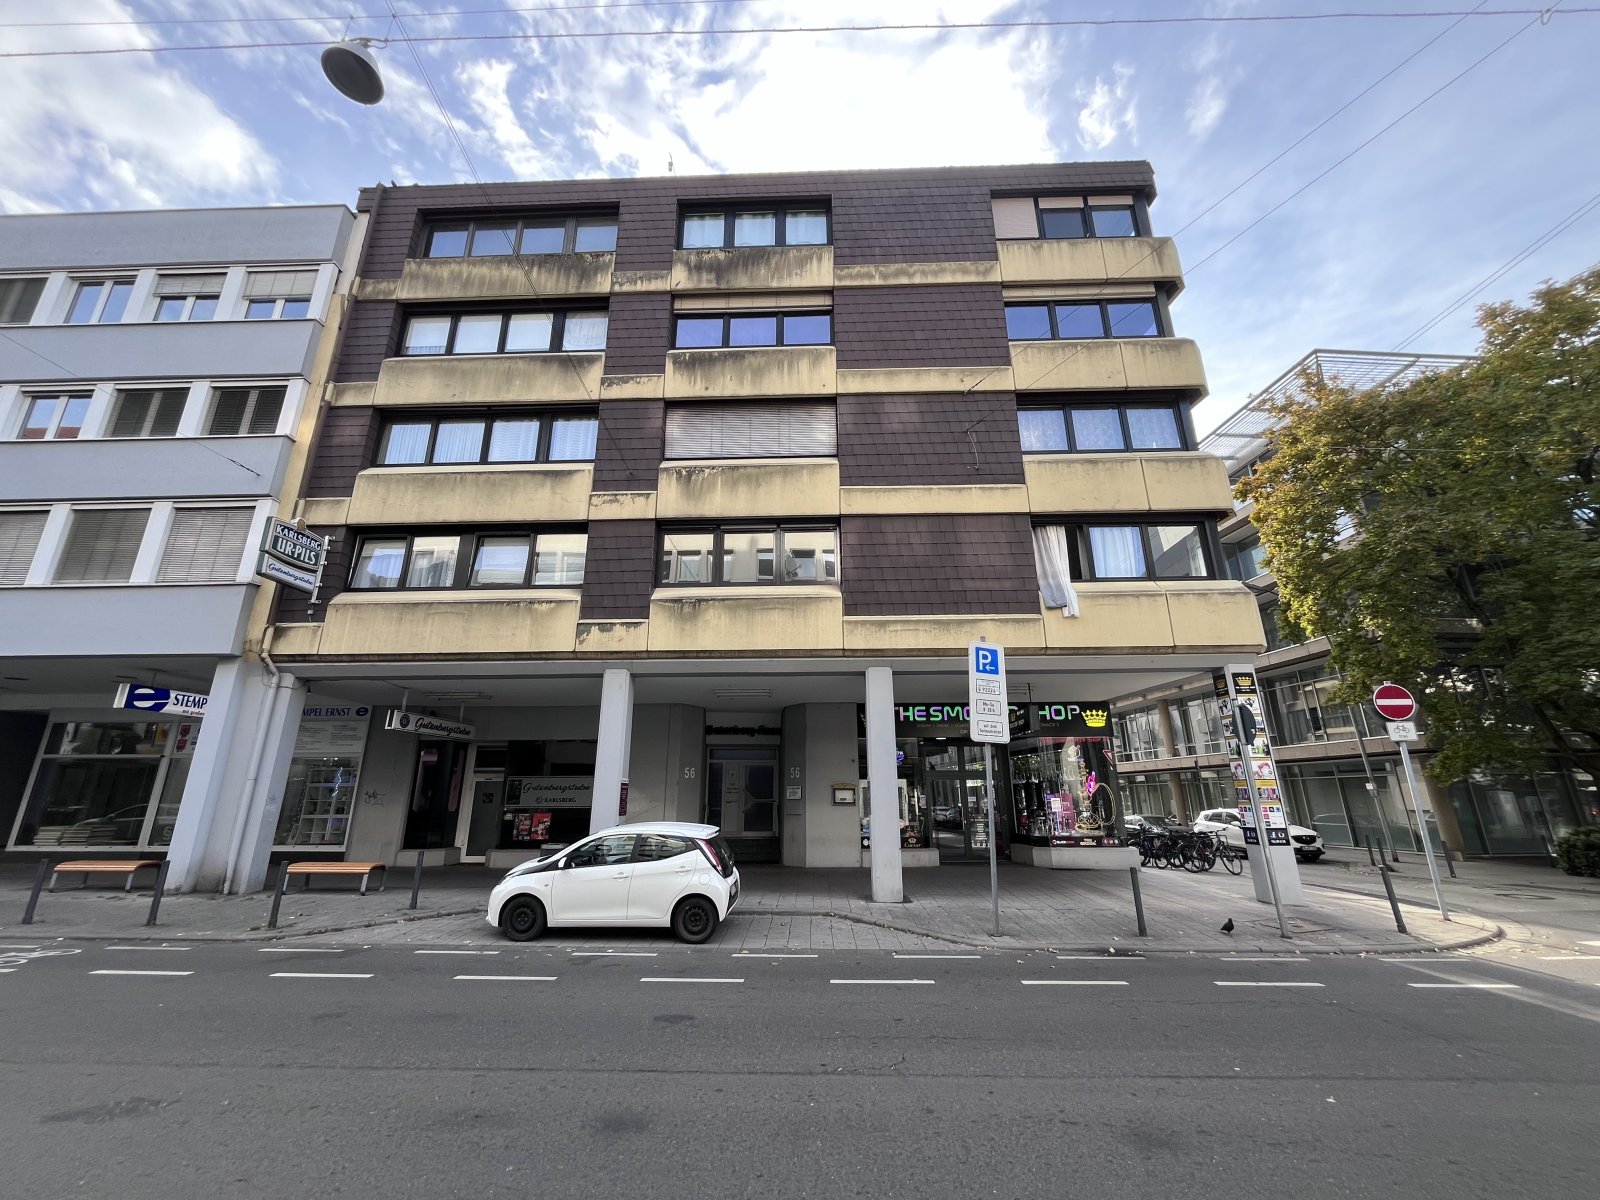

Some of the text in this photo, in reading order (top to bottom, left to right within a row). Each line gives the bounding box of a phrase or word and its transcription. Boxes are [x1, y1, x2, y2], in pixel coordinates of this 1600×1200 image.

[276, 524, 321, 550] KARLSBERG
[979, 650, 991, 670] P
[325, 707, 352, 717] ERNST
[414, 717, 471, 736] Gutenbergstube
[684, 767, 696, 779] 56
[790, 767, 800, 779] 56
[522, 782, 591, 794] Gutenbergstube
